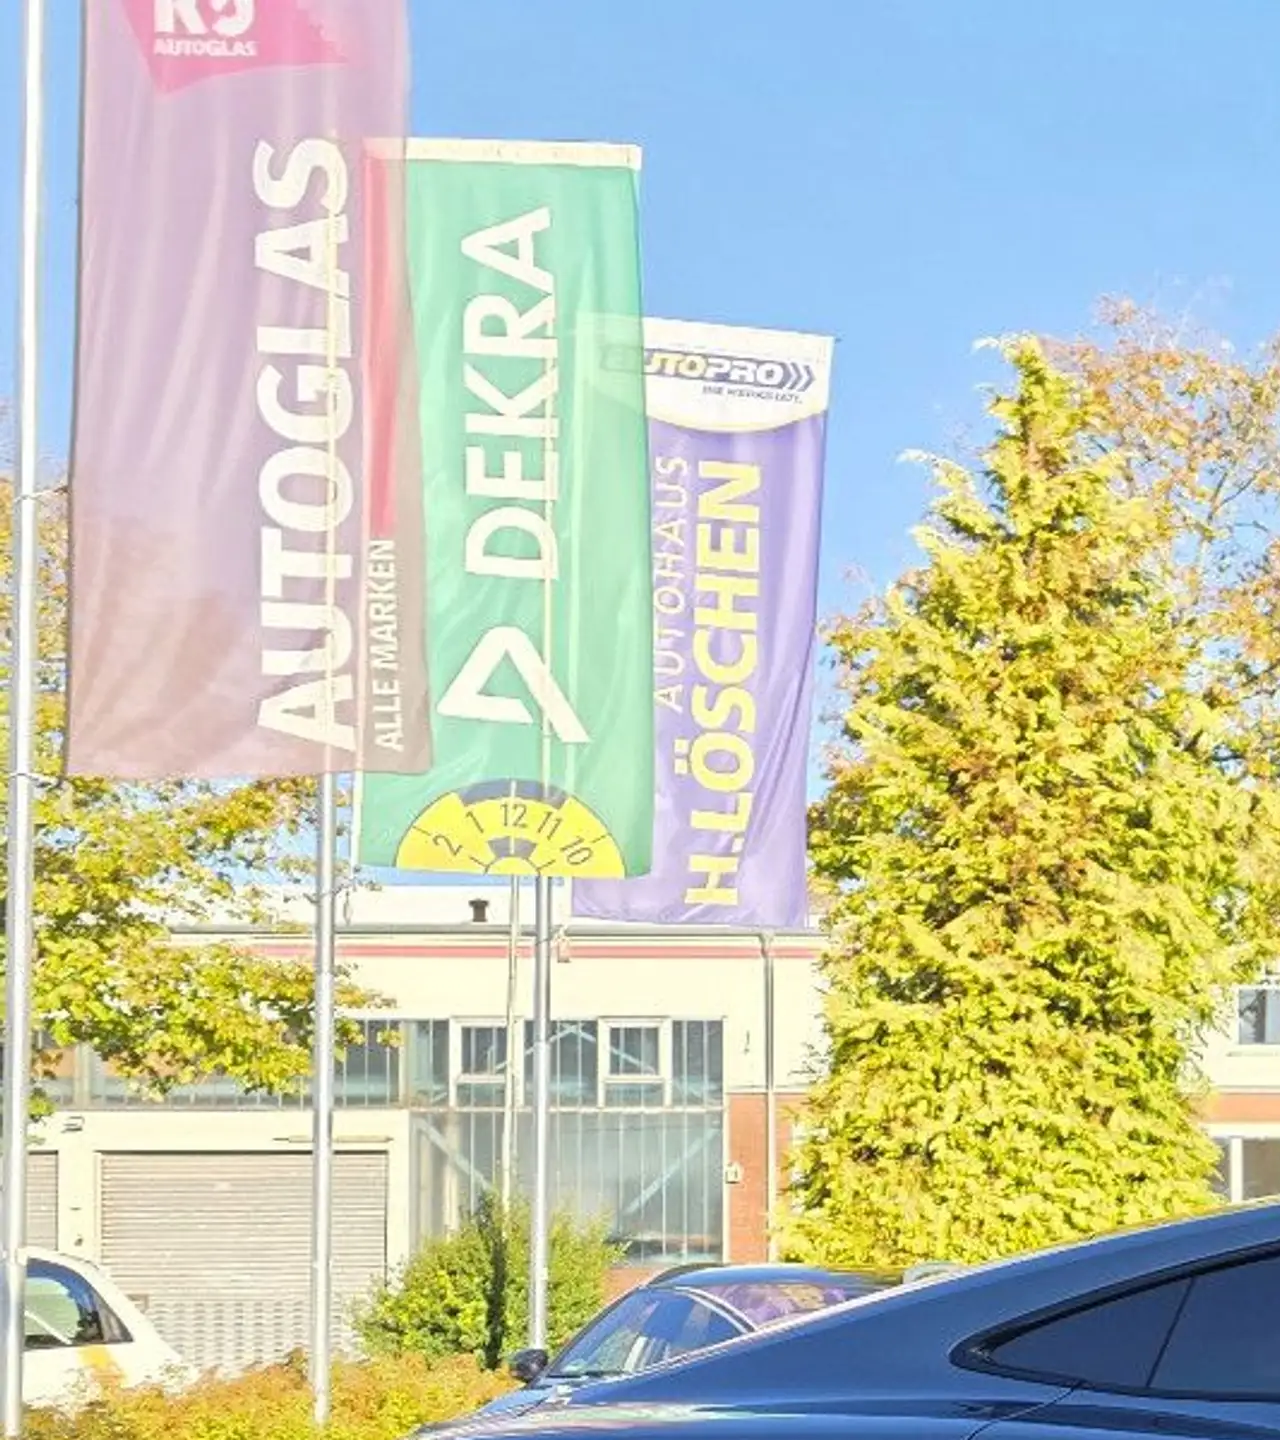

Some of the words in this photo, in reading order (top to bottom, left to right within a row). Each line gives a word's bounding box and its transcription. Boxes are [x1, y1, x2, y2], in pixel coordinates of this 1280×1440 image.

[153, 38, 259, 56] AUTOGLAS
[253, 138, 356, 752] AUTOGLAS
[461, 207, 560, 581] DEKRA
[368, 539, 398, 670] MARKEN
[653, 456, 688, 714] AUTOHAUS
[372, 678, 404, 752] ALLE
[500, 803, 528, 828] 12
[536, 811, 563, 841] 11
[560, 835, 593, 866] 10
